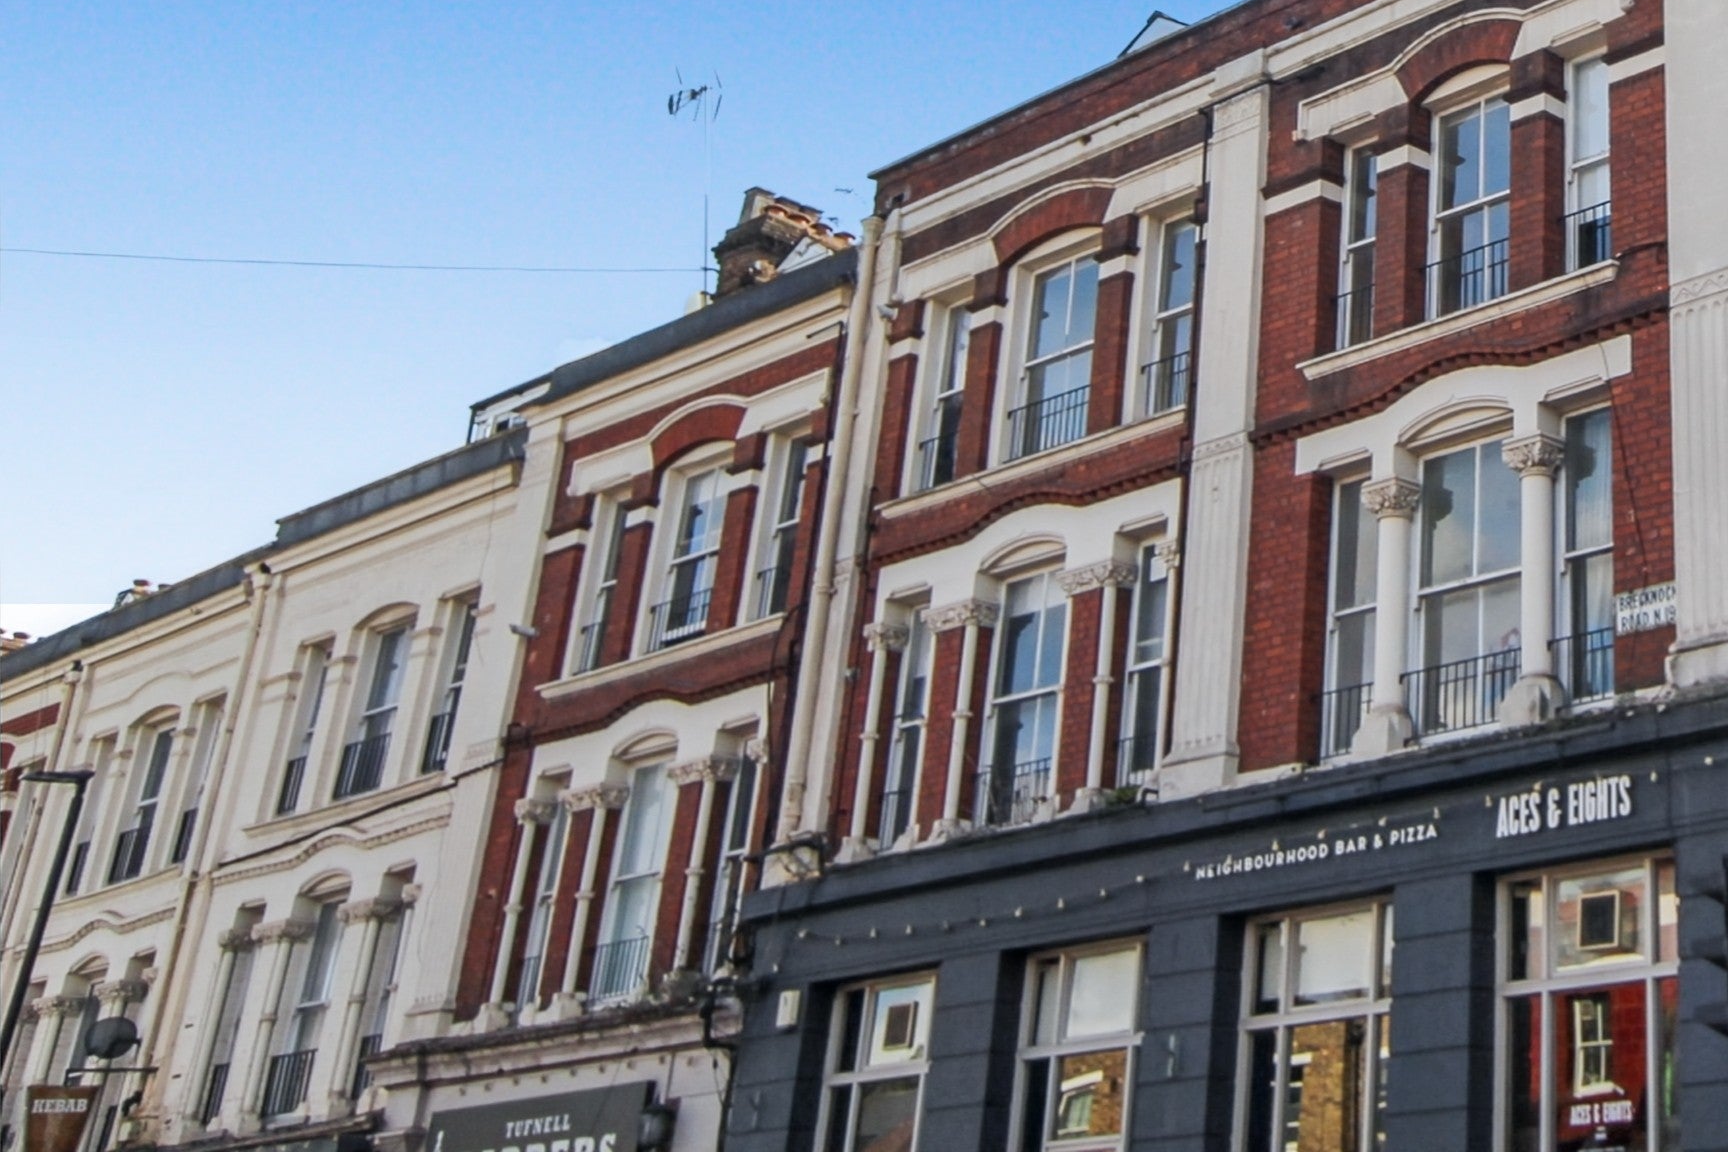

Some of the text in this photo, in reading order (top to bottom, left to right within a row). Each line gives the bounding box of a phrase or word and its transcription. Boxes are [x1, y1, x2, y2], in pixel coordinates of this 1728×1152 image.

[1496, 775, 1632, 838] ACES & EIGHTS
[1195, 823, 1438, 880] NEIGHBOURHOOD BAR & PIZZA
[31, 1098, 88, 1114] KEBAB
[506, 1114, 571, 1139] TUFNELL
